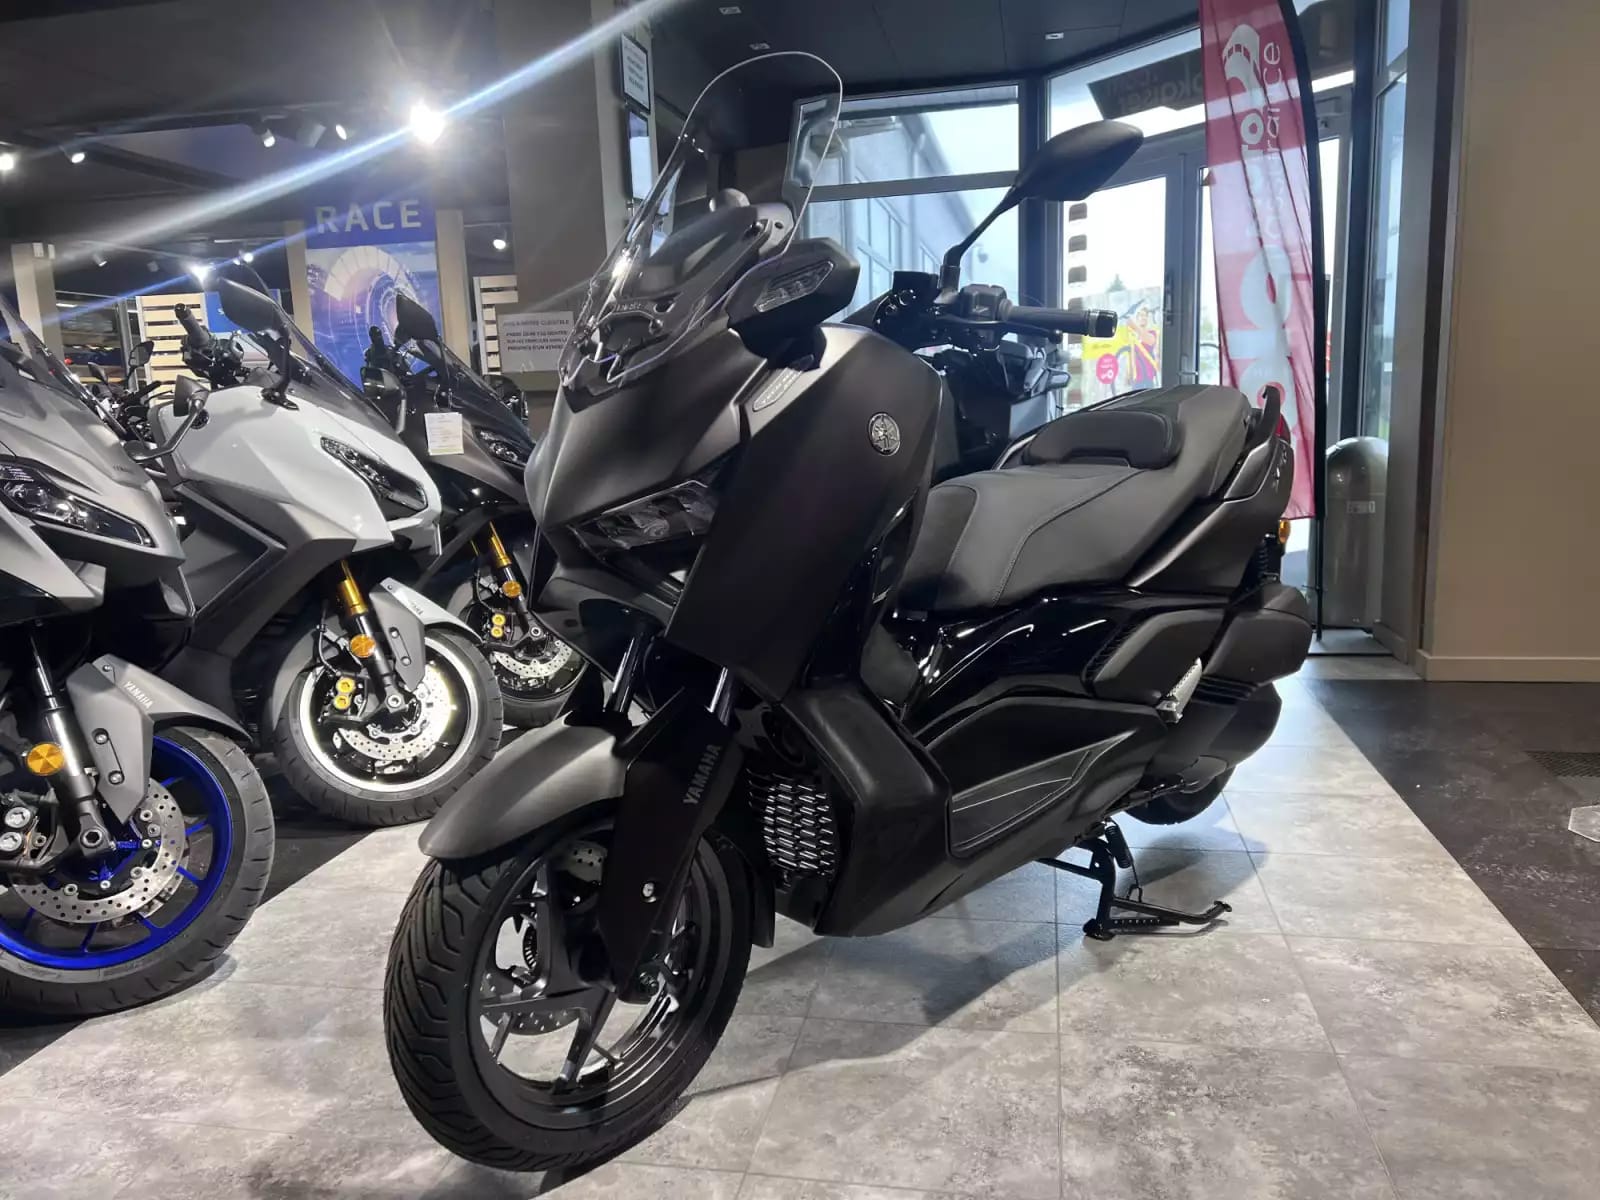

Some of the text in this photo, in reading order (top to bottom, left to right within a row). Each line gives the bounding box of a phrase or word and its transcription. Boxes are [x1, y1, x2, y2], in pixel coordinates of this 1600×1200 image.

[315, 200, 422, 234] RACE
[123, 680, 154, 709] YAMAHA
[682, 744, 722, 805] YAMAHA
